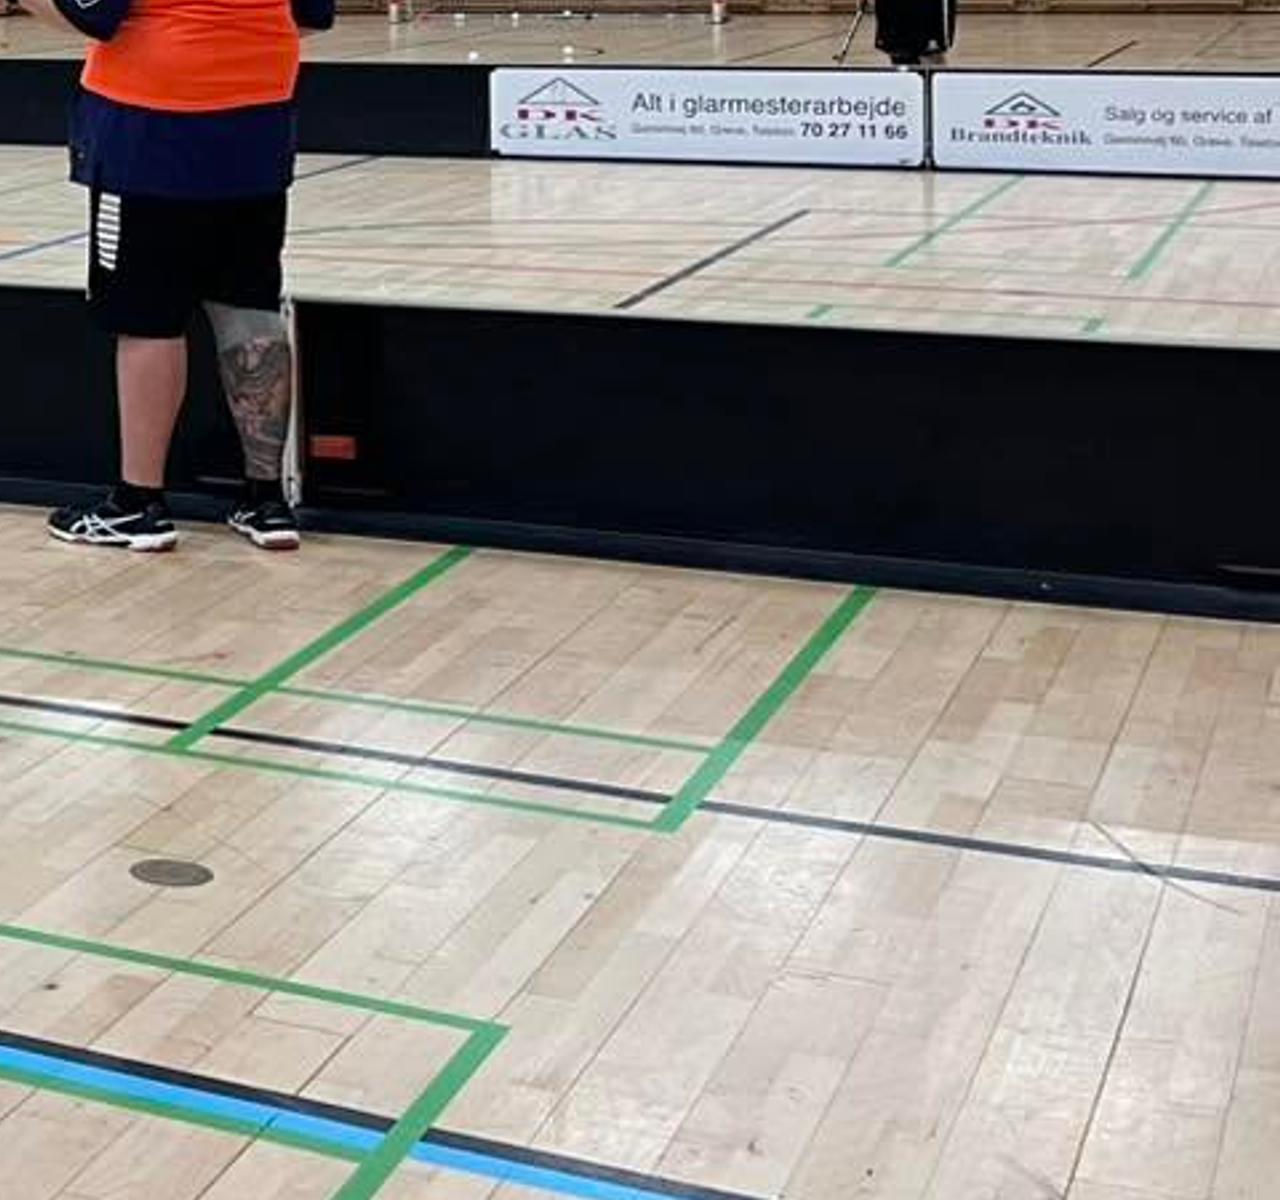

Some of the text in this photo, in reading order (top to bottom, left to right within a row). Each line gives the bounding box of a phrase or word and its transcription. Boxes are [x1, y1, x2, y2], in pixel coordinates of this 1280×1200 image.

[632, 92, 906, 120] Alt i glarmesterarbejde
[1105, 105, 1273, 126] Salg og service af
[801, 122, 824, 138] 70
[827, 122, 851, 138] 27
[859, 123, 877, 139] 11
[884, 124, 908, 140] 66
